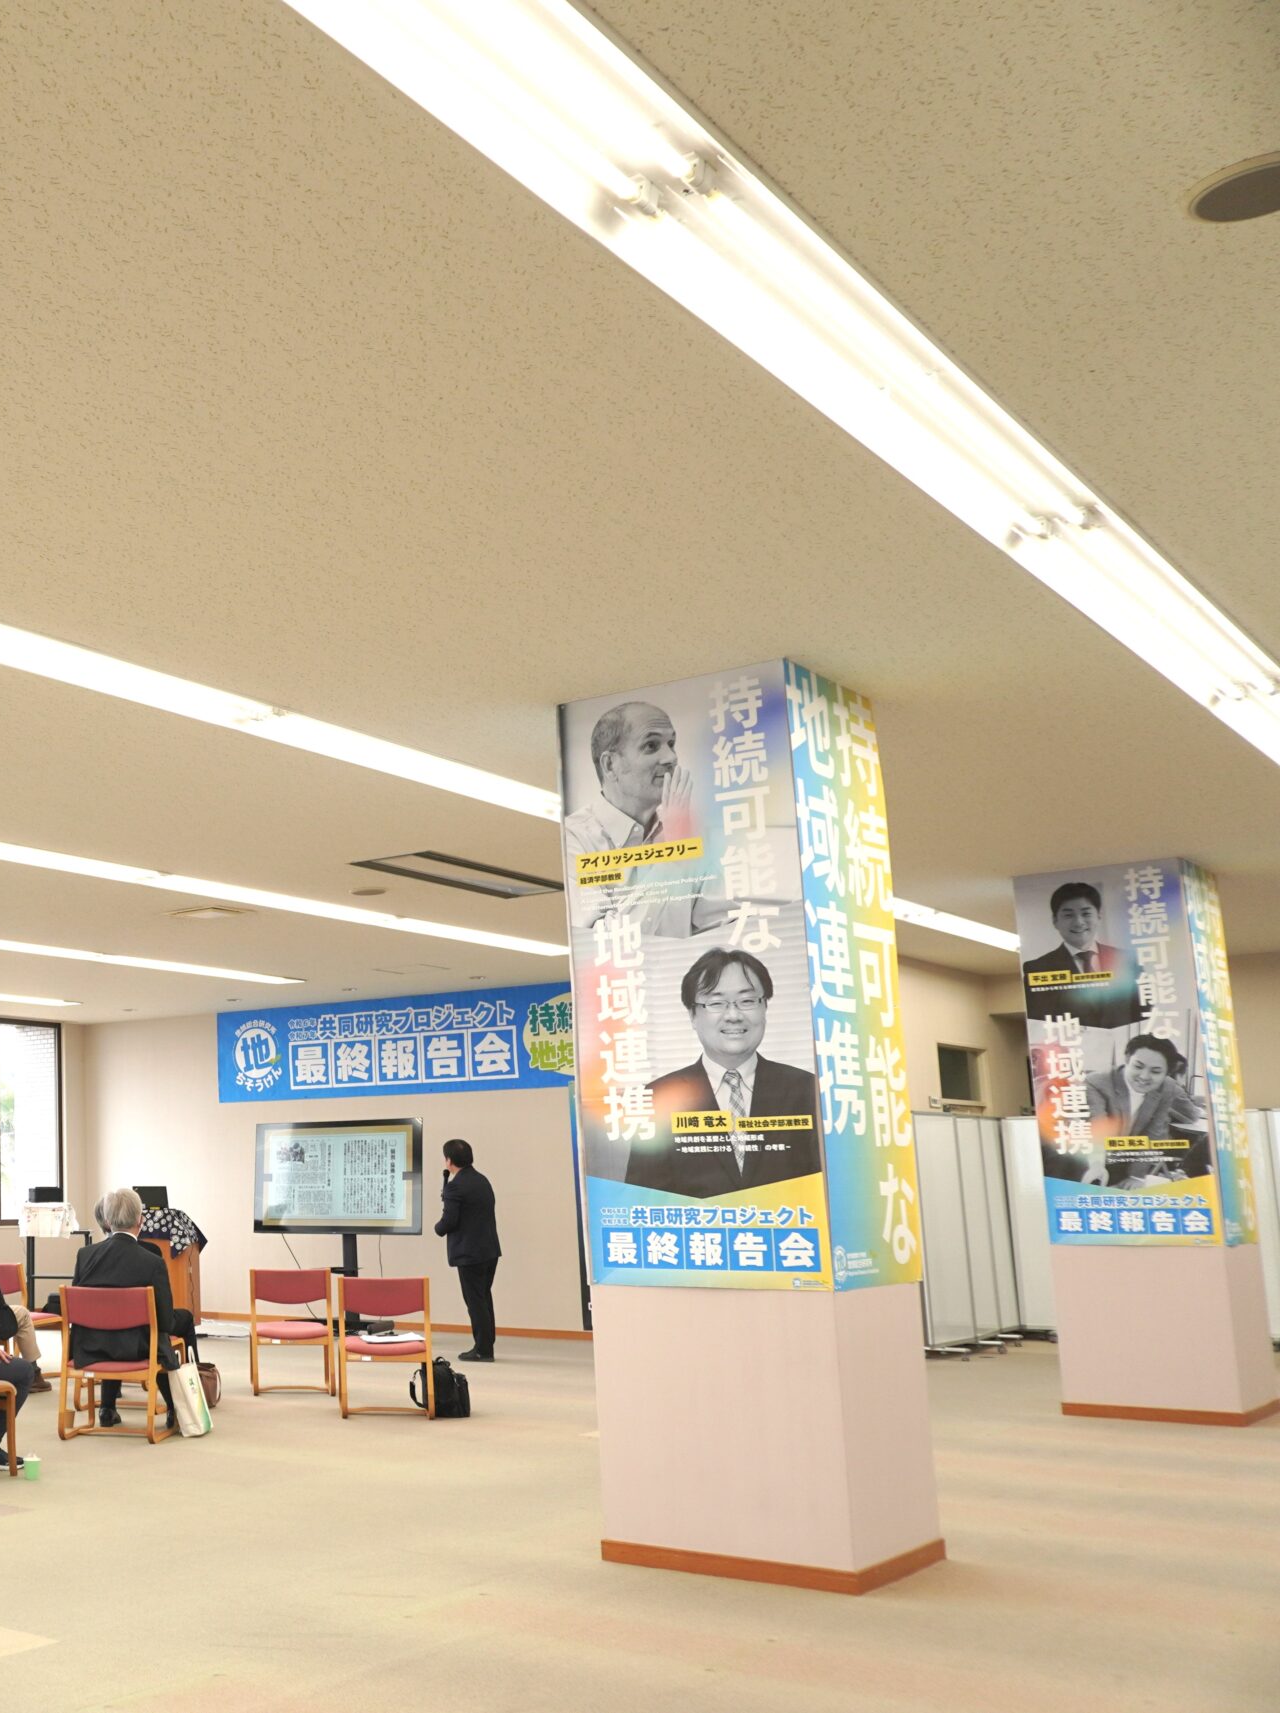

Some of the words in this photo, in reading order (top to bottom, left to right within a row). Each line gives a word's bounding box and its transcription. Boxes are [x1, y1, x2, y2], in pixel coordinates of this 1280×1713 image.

[708, 675, 782, 953] 持続可能な
[580, 844, 698, 869] アイリッシュジェフリー
[784, 660, 866, 1136] 地域連携
[833, 683, 918, 1265] 持続可能な
[1123, 867, 1182, 1041] 持続可能な
[318, 1000, 515, 1040] 共同研究プロジェクト
[592, 914, 657, 1142] 地域連携
[240, 1033, 272, 1074] 地
[296, 1031, 512, 1084] 最終報告会
[1042, 1013, 1095, 1156] 地域連携
[630, 1206, 815, 1227] 共同研究プロジェクト
[1059, 1210, 1211, 1233] 最終報告会
[1076, 1194, 1209, 1208] 共同研究プロジェクト
[606, 1231, 816, 1269] 最終報告会
